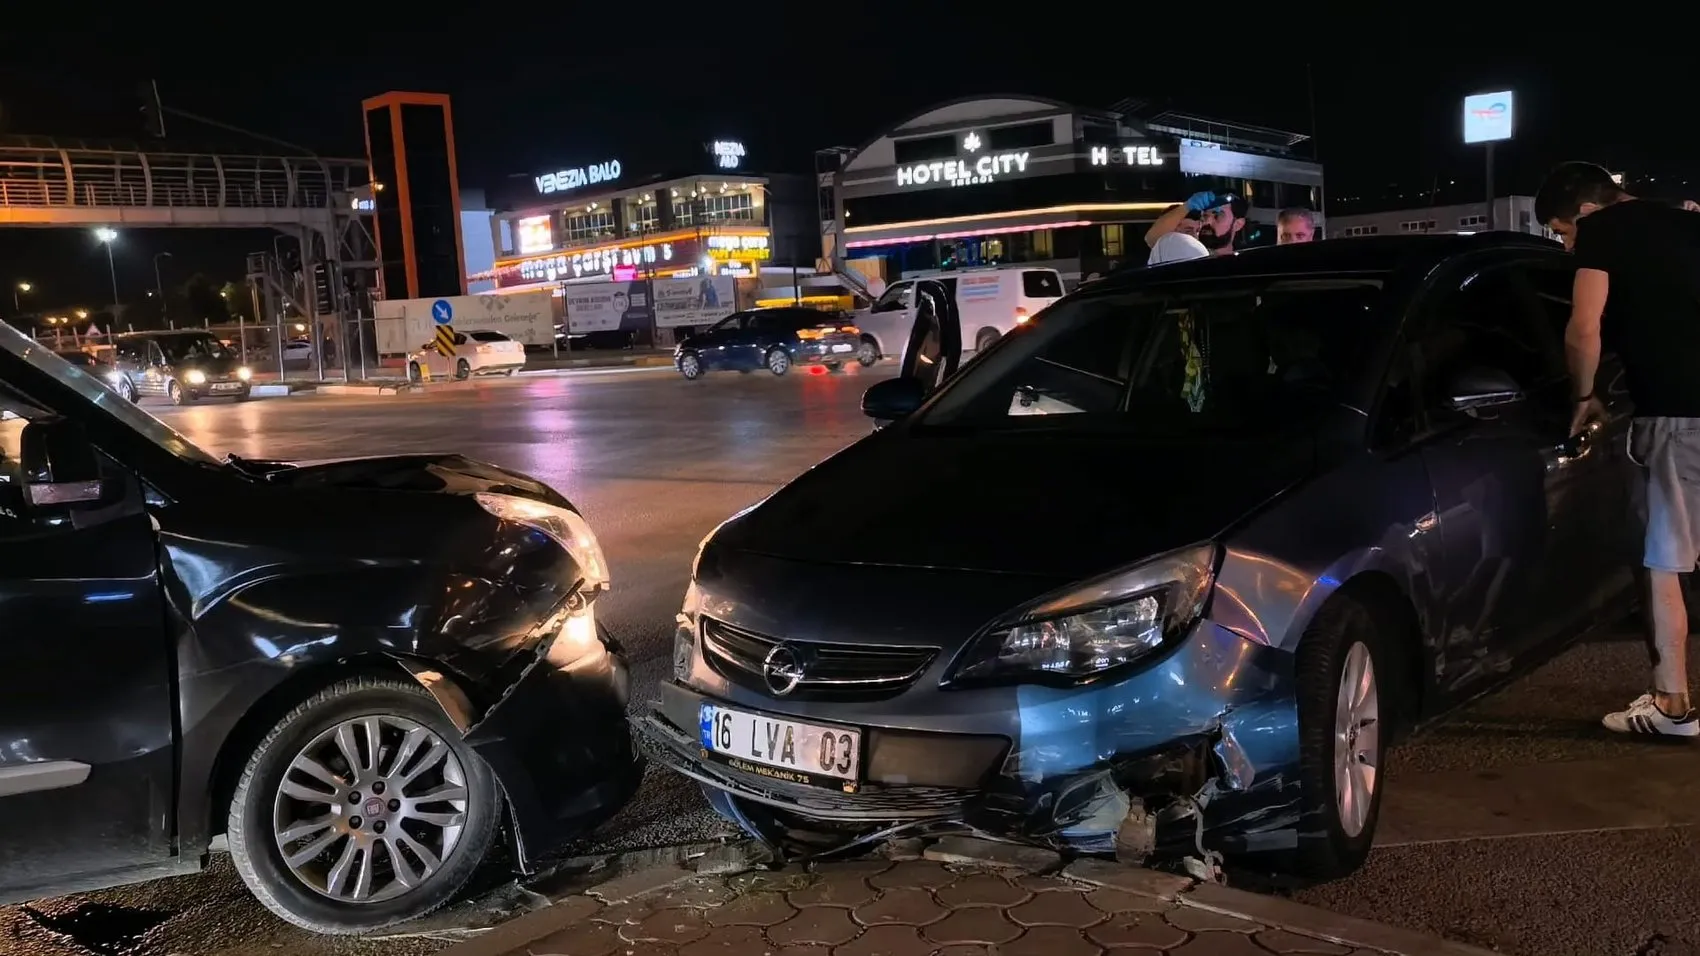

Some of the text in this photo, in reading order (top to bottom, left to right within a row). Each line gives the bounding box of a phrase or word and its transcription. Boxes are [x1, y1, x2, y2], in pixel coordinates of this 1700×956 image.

[535, 159, 621, 194] VENEZIA BALO
[897, 152, 1029, 186] HOTEL CITY
[714, 712, 732, 749] 16
[819, 731, 853, 774] 03
[797, 774, 810, 784] 75
